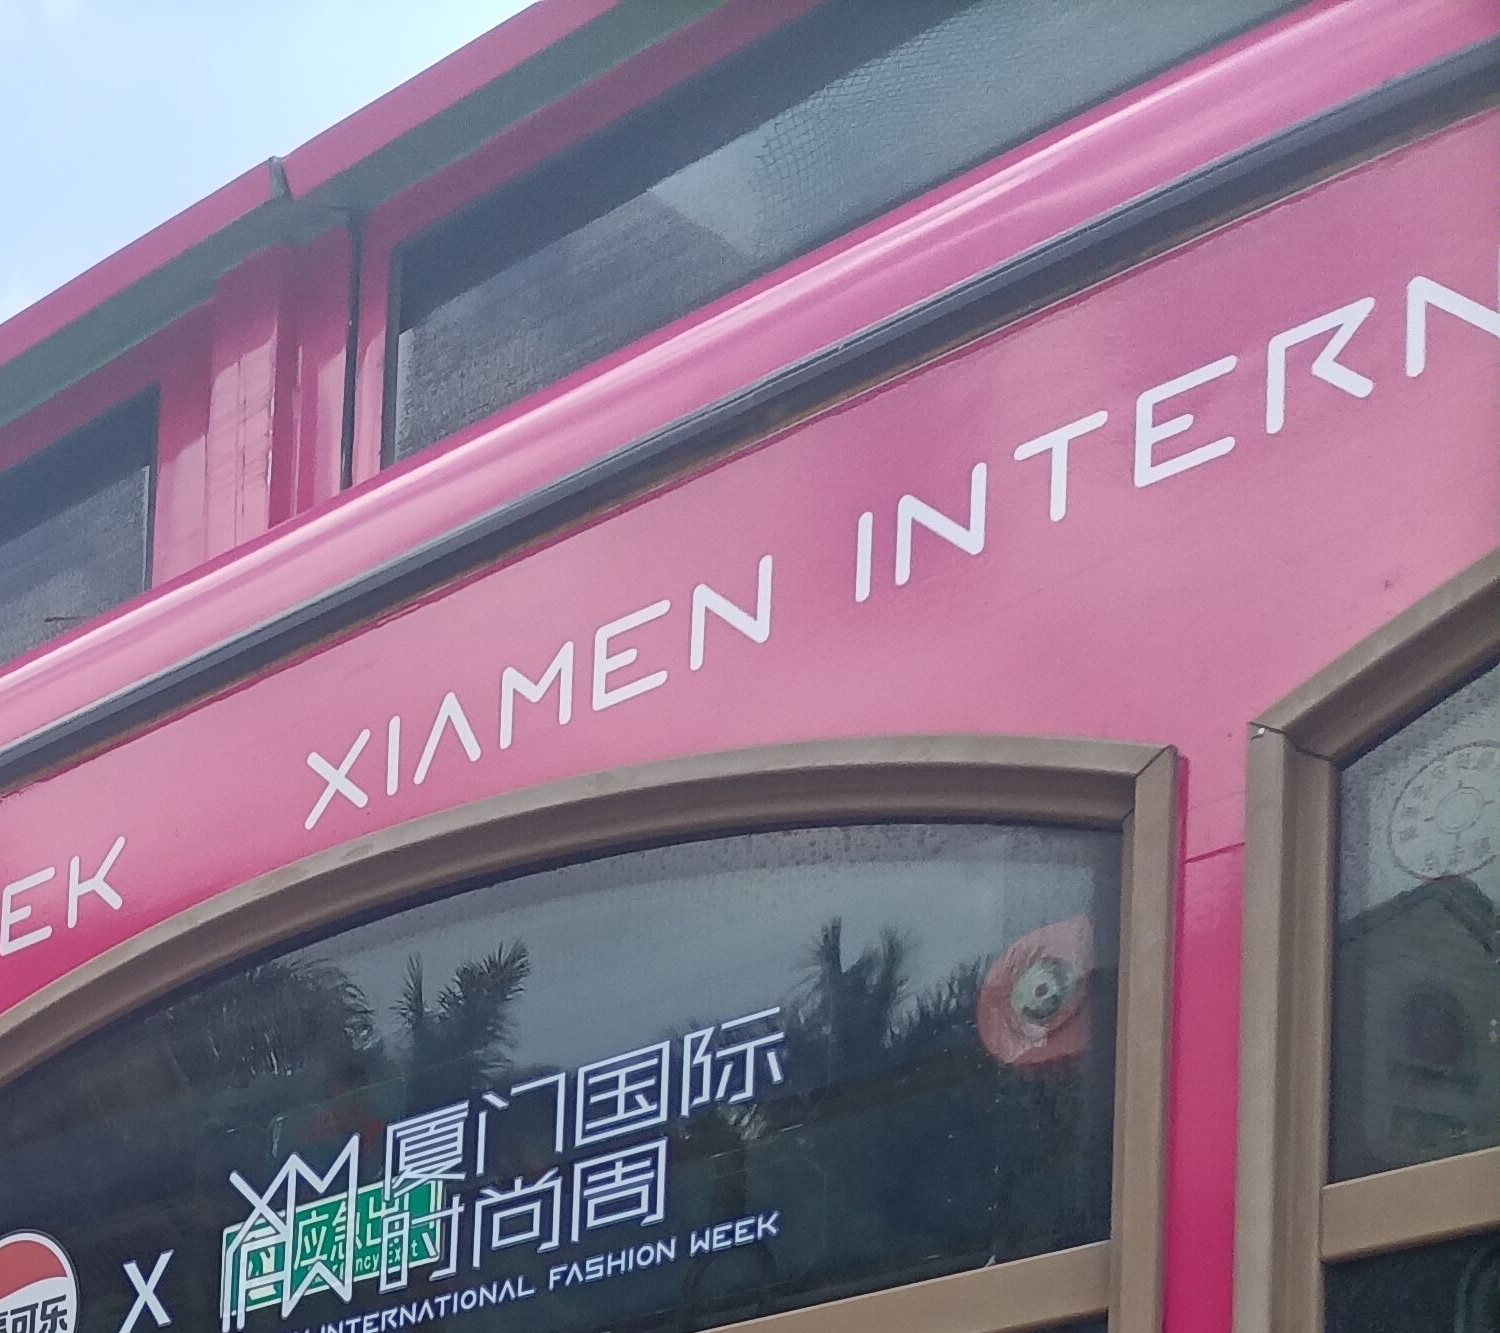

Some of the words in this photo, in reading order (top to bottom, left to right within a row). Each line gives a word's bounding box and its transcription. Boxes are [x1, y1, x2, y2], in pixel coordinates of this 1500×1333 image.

[304, 554, 772, 829] XIAMEN
[855, 273, 1500, 602] INTERN
[383, 1007, 784, 1201] 厦门国际
[379, 1137, 667, 1294] 时尚周
[549, 1236, 678, 1291] FASHION
[690, 1211, 781, 1256] WEEK
